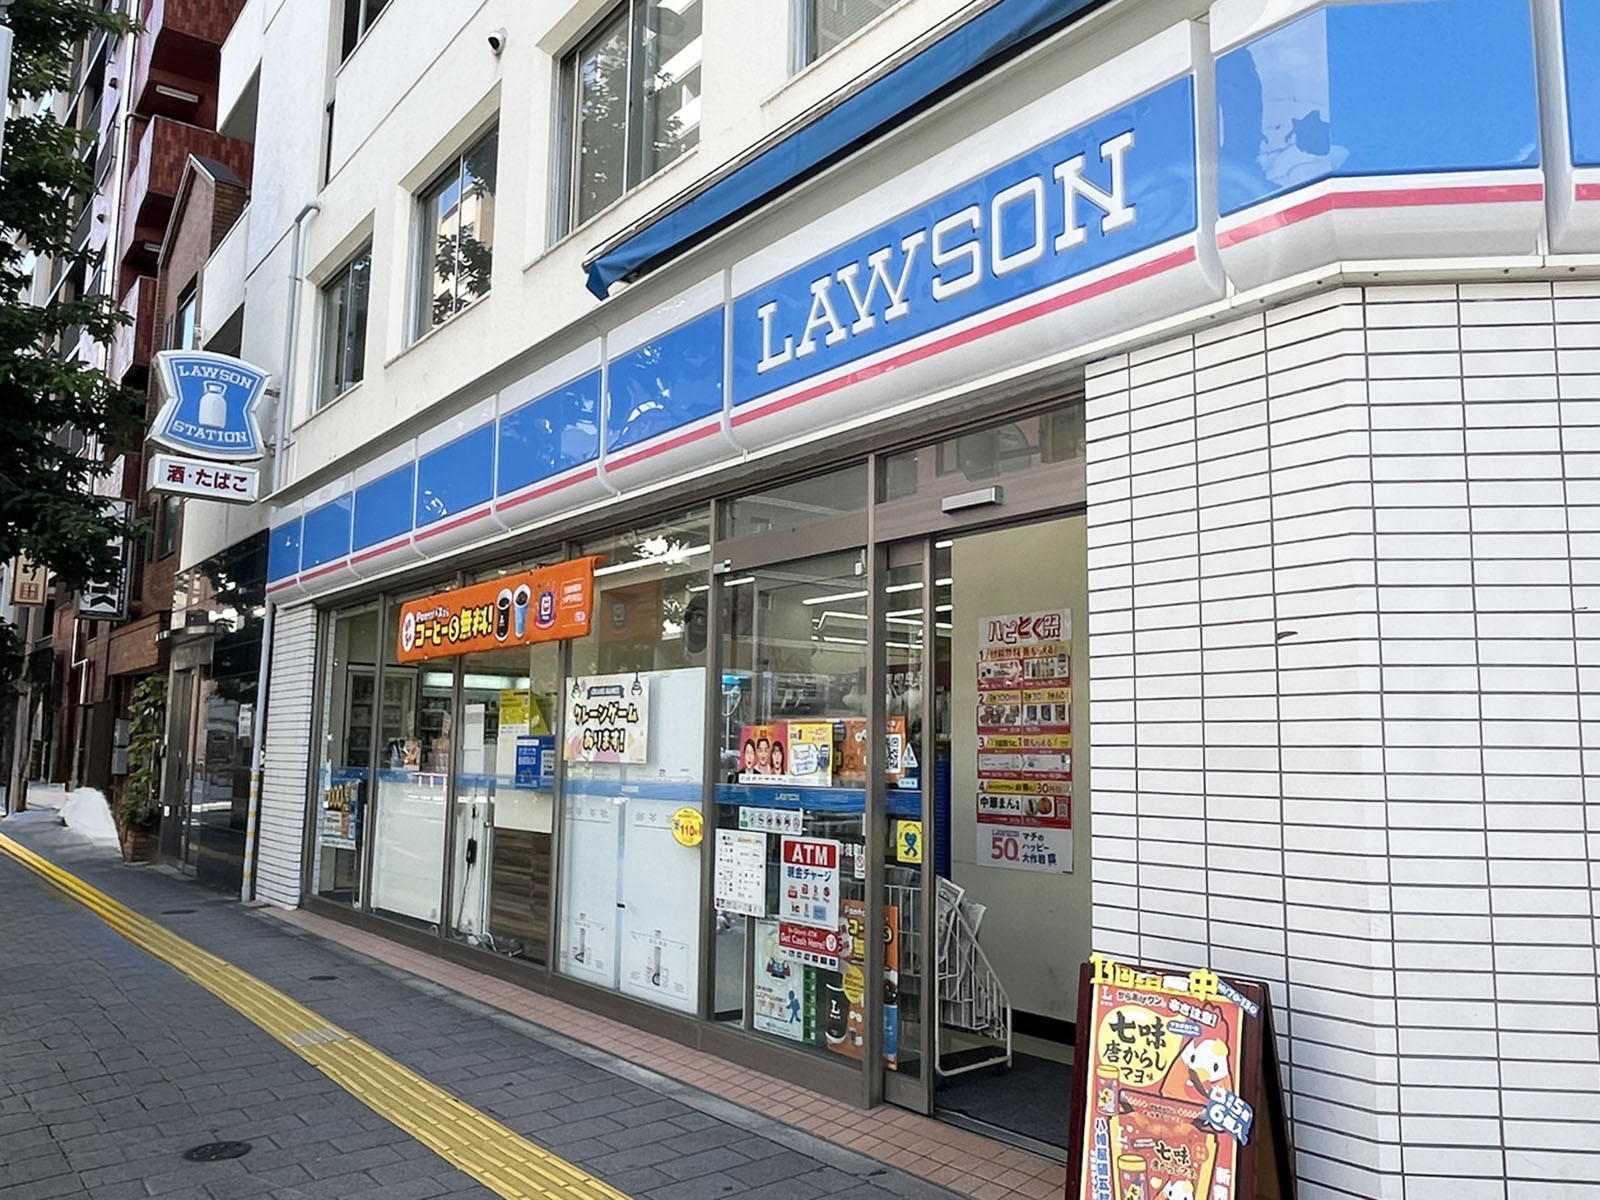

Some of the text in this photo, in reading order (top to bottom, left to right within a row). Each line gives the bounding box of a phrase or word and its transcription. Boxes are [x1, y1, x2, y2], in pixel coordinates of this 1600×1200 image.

[757, 131, 1136, 374] LAWSON
[178, 365, 253, 389] LAWSON
[173, 420, 249, 443] STATION
[167, 464, 248, 492] 酒・たばこ
[573, 701, 639, 725] クレーンゲーム
[583, 728, 626, 752] あります!
[791, 843, 829, 866] ATM
[787, 865, 832, 882] 現金チャージ
[1109, 1010, 1167, 1050] 七味
